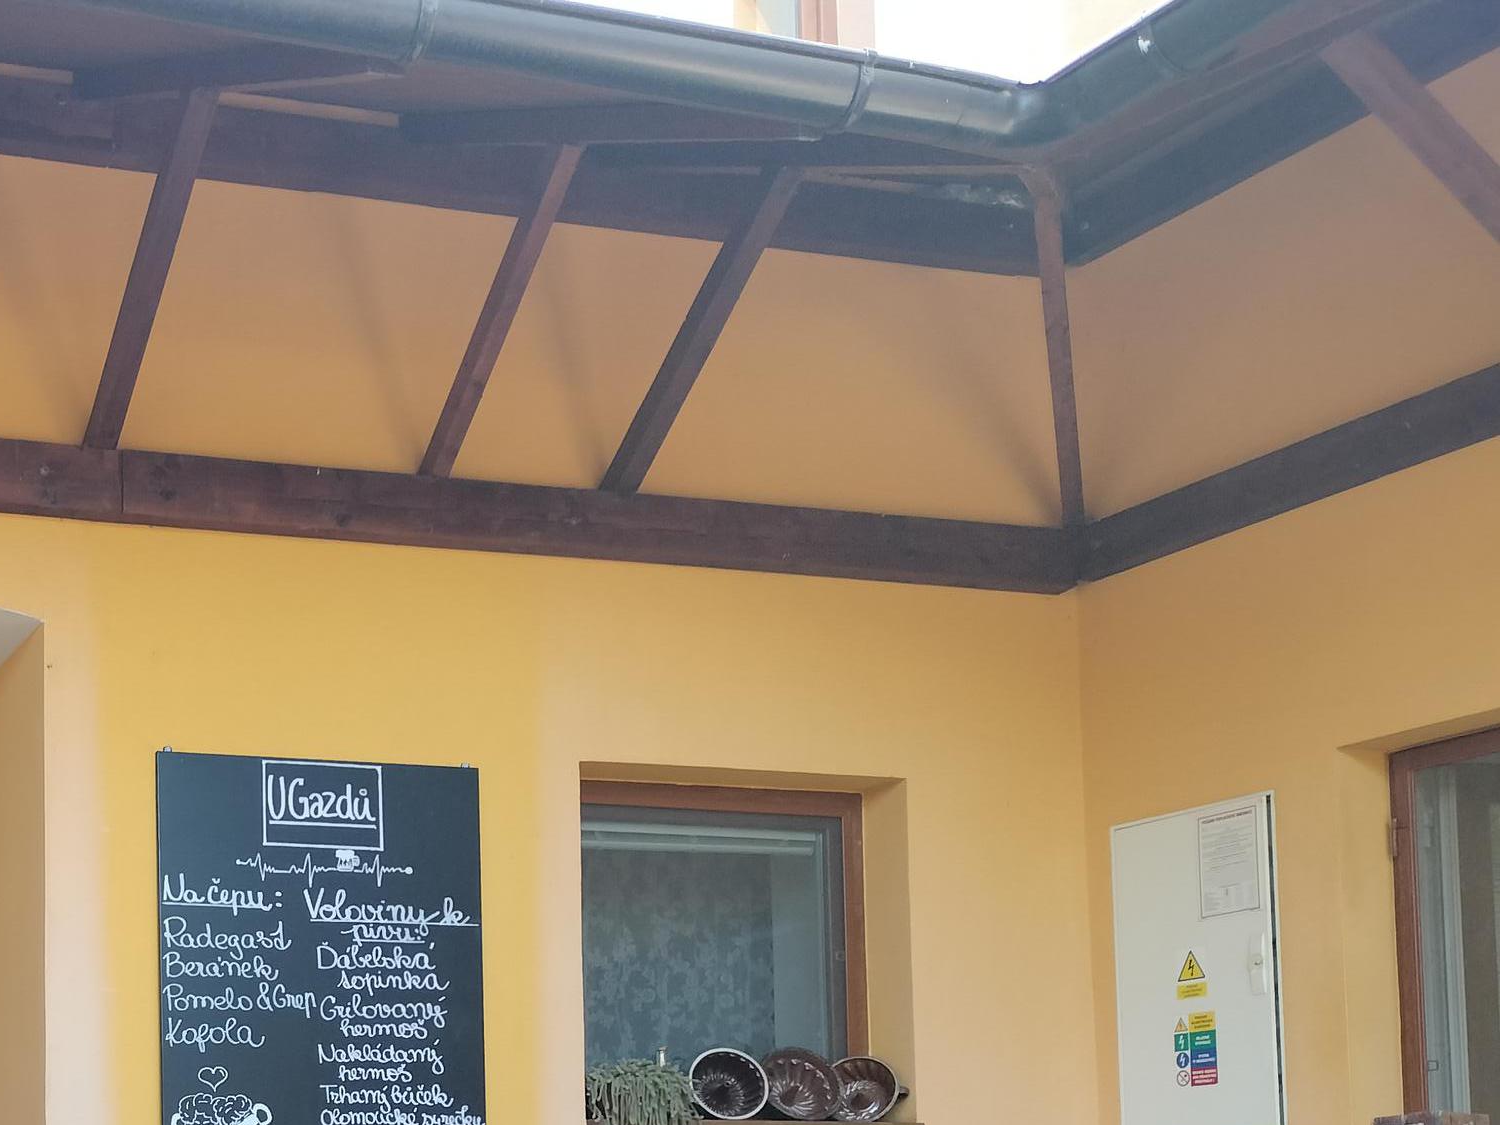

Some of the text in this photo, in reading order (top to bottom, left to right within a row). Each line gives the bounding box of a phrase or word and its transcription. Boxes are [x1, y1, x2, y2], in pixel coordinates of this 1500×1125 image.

[303, 887, 440, 936] Voloviny
[163, 916, 292, 960] Radegast
[162, 951, 279, 981] Beránek
[162, 983, 253, 1011] Pomelo
[320, 993, 448, 1028] Grilovaný
[165, 1017, 265, 1053] Kofola
